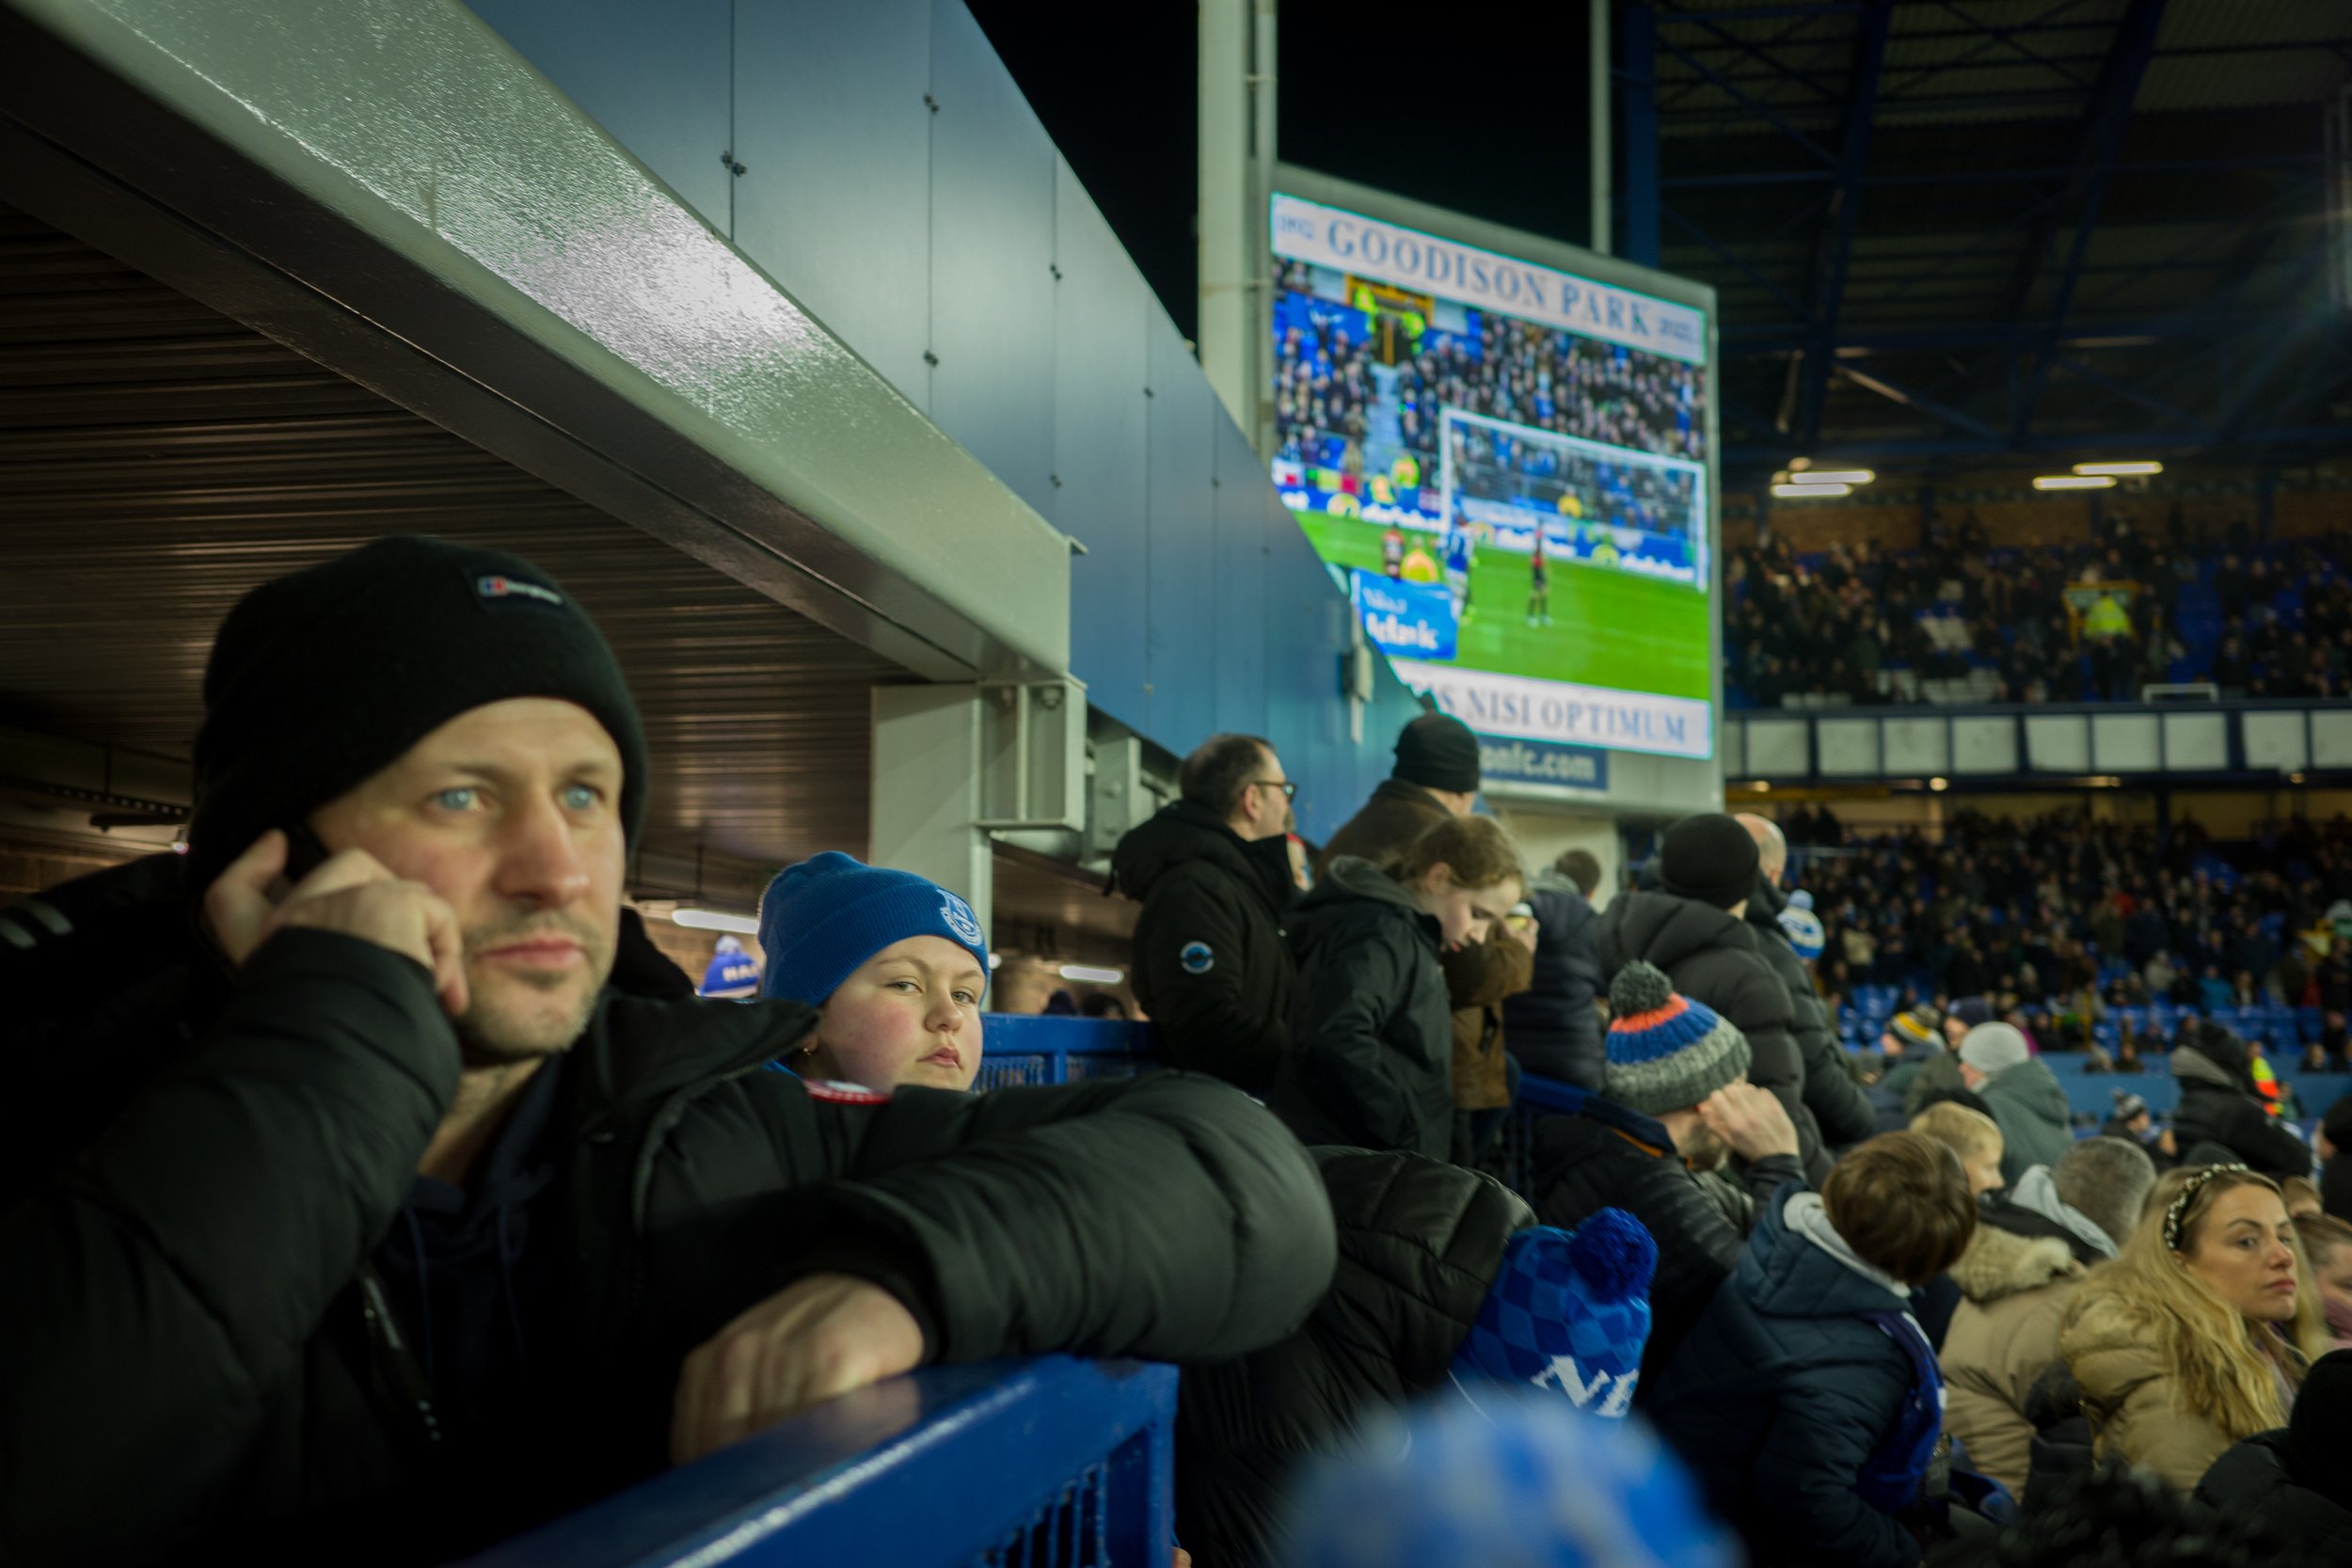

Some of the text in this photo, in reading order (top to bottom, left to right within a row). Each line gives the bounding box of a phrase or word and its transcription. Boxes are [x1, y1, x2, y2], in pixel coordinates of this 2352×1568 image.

[1327, 218, 1548, 311] GOODISON
[1561, 282, 1651, 337] PARK
[1467, 687, 1532, 726] NISI
[1540, 702, 1686, 745] OPTIMUM
